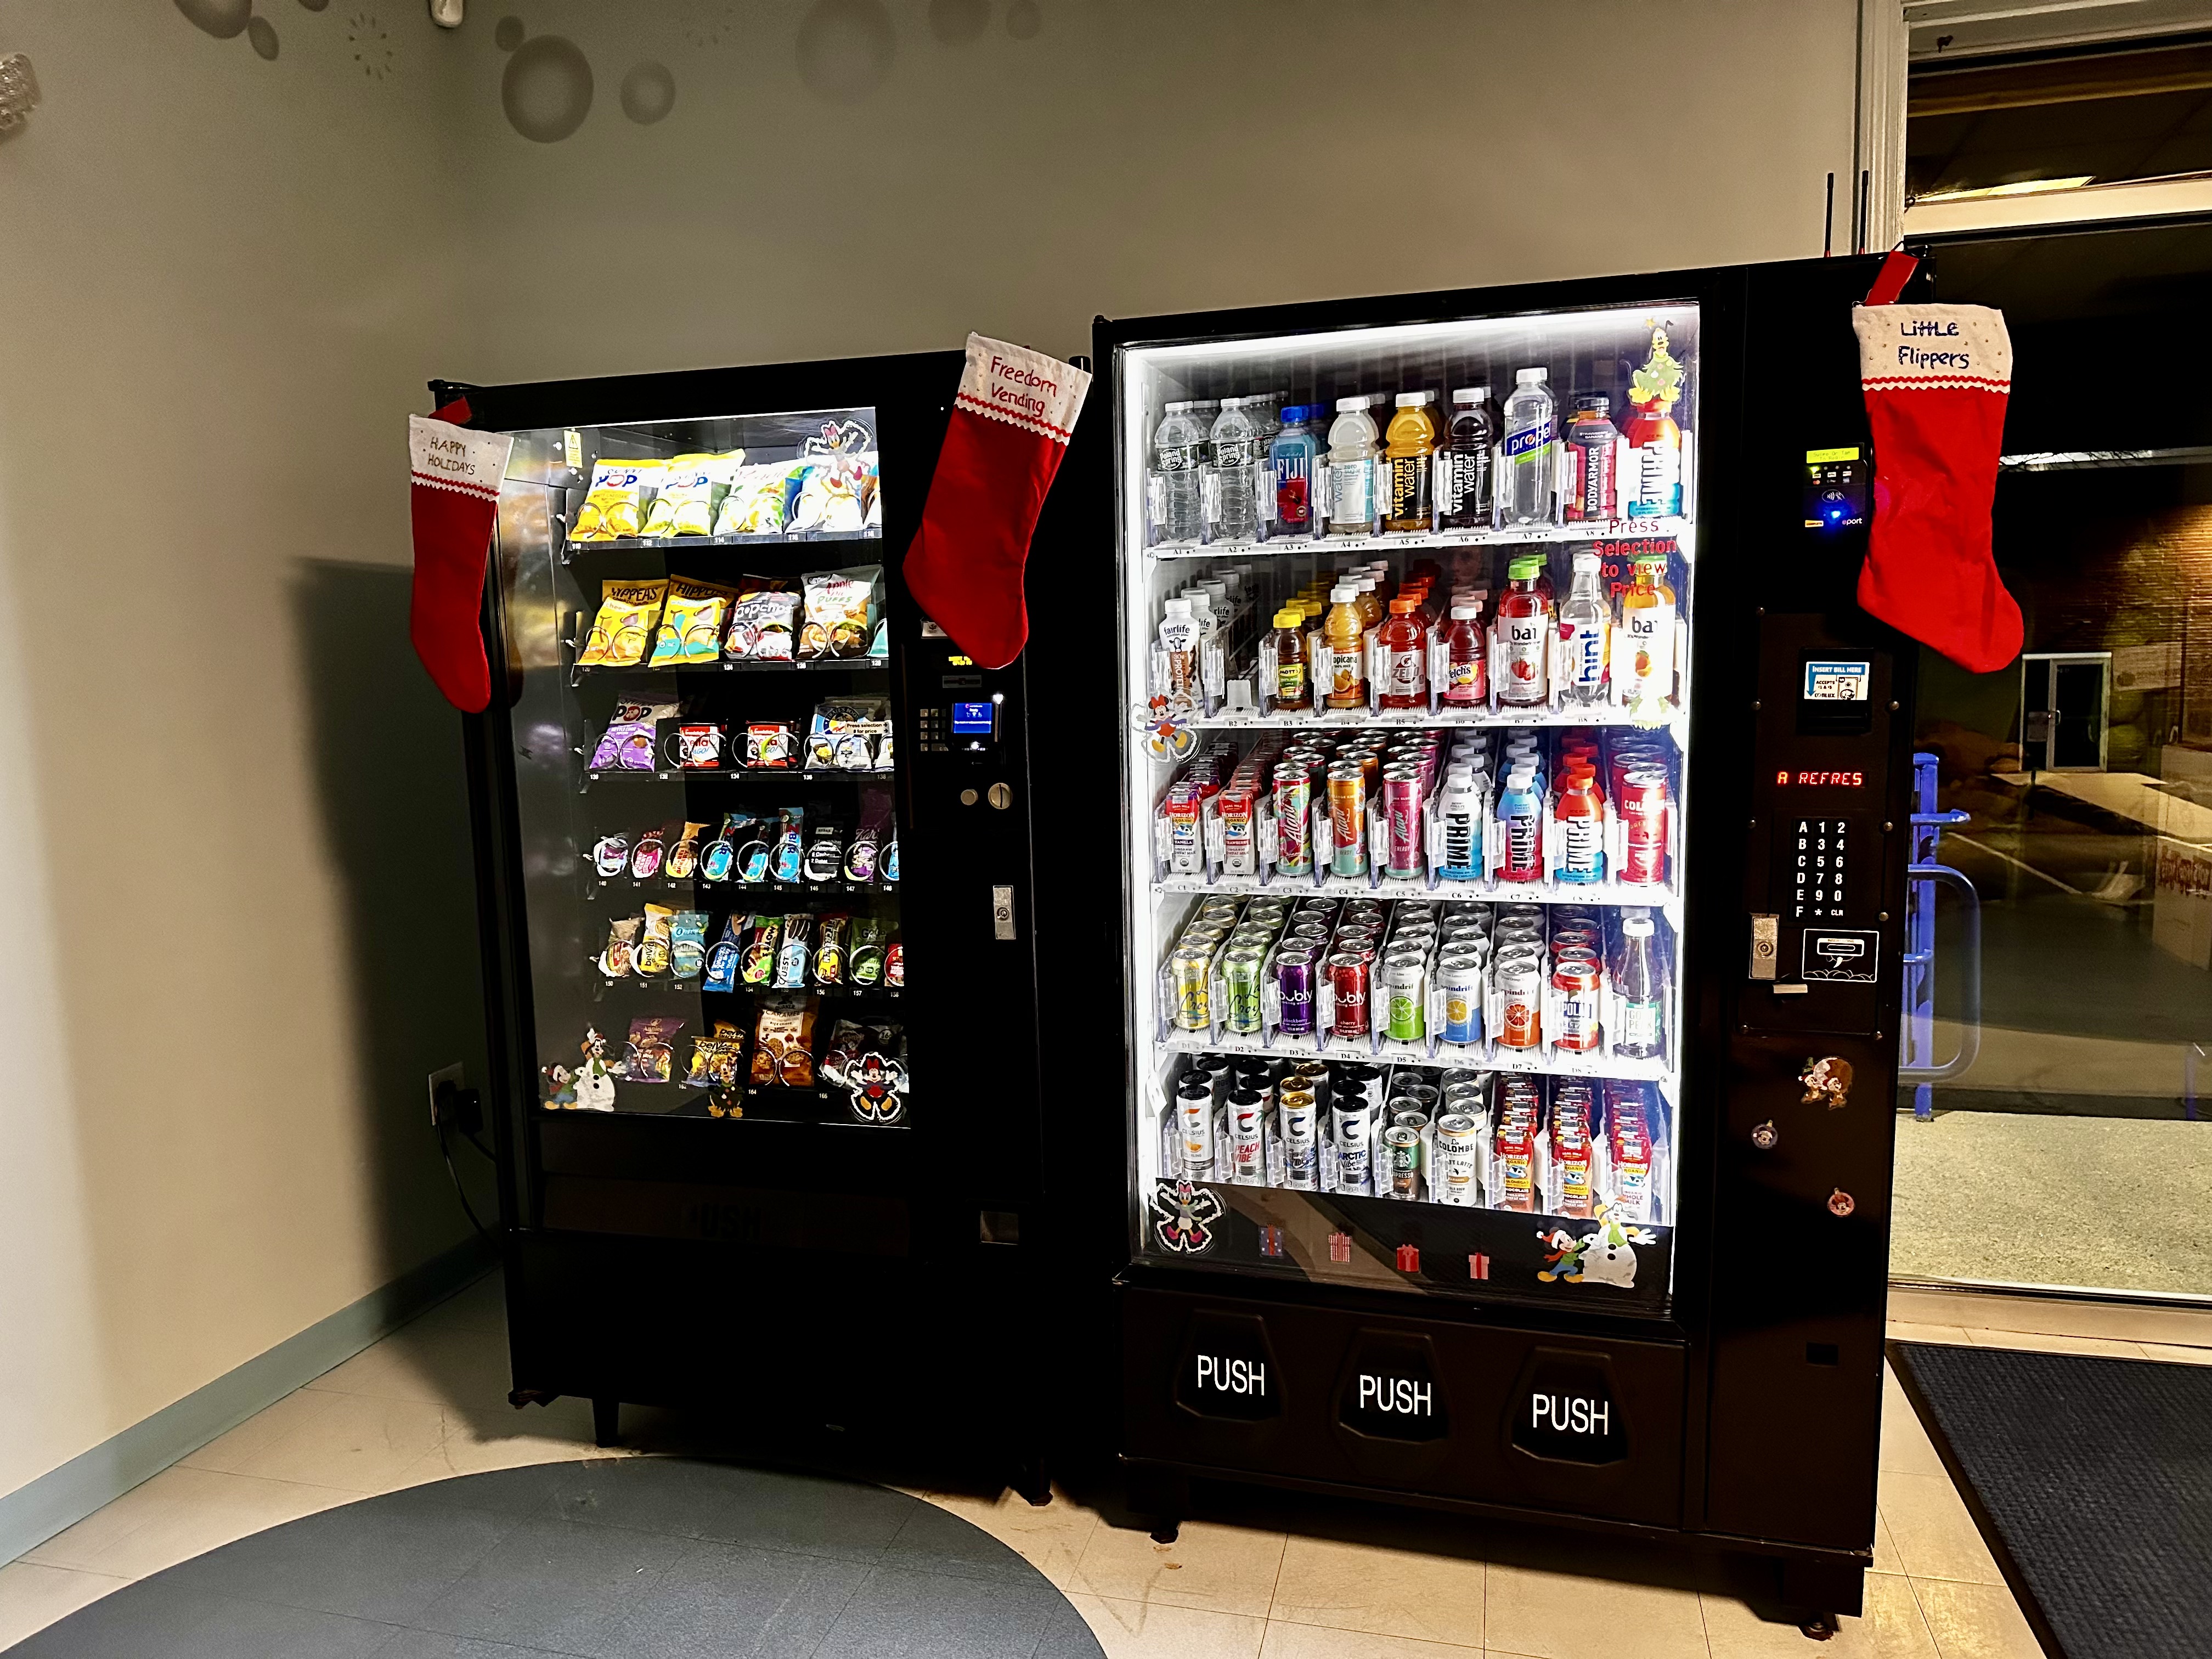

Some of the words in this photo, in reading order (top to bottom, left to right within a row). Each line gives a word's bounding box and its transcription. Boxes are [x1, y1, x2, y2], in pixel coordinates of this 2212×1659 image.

[1898, 346, 1970, 369] Flippers
[991, 356, 1057, 397] Freedom
[991, 382, 1045, 417] Vending
[430, 437, 466, 457] HAPPY
[1160, 448, 1181, 461] Poland
[1217, 444, 1239, 456] Poland
[427, 453, 476, 475] HOLIDAYS
[1161, 455, 1183, 468] Spring
[1218, 451, 1241, 464] Spring
[1277, 458, 1305, 480] FIJI
[1464, 454, 1476, 494] water
[1333, 466, 1342, 503] water
[1404, 458, 1415, 498] water
[1453, 454, 1464, 514] vitamin
[1587, 447, 1600, 512] BODYARMOR
[1393, 459, 1404, 517] vitamin
[1609, 520, 1659, 534] Press
[1593, 538, 1677, 556] Selection
[1601, 562, 1619, 578] to
[1627, 562, 1667, 576] view
[1611, 582, 1655, 597] Price
[817, 596, 853, 604] PUFFS
[1164, 625, 1190, 635] fairlife
[1333, 655, 1357, 664] opicana
[1578, 629, 1600, 682] hint
[612, 705, 653, 721] POP
[1777, 771, 1788, 785] A
[1798, 772, 1863, 785] REFRES
[1798, 822, 1808, 833] A
[1819, 822, 1825, 833] 1
[1837, 822, 1845, 833] 2
[1446, 812, 1471, 870] PRIME
[1510, 815, 1536, 872] PRIME
[1566, 816, 1594, 873] PRIME
[1798, 839, 1807, 850] B
[1818, 839, 1825, 850] 3
[1836, 839, 1844, 850] 4
[1798, 855, 1806, 867] C
[1816, 856, 1825, 867] 5
[1835, 856, 1843, 867] 6
[1797, 872, 1805, 884] D
[1816, 873, 1824, 884] 7
[1835, 873, 1843, 884] 8
[1796, 889, 1804, 901] E
[1815, 890, 1823, 901] 9
[1834, 890, 1842, 901] 0
[1796, 906, 1804, 917] F
[1235, 1141, 1260, 1154] PEACH
[1439, 1140, 1474, 1153] COLOMBE
[1235, 1153, 1252, 1163] VIBE
[1338, 1150, 1367, 1160] ARCTIC
[1500, 1152, 1529, 1161] HORIZON
[1559, 1158, 1587, 1166] HORIZON
[1198, 1355, 1265, 1396] PUSH
[1359, 1374, 1432, 1416] PUSH
[1532, 1393, 1609, 1435] PUSH
